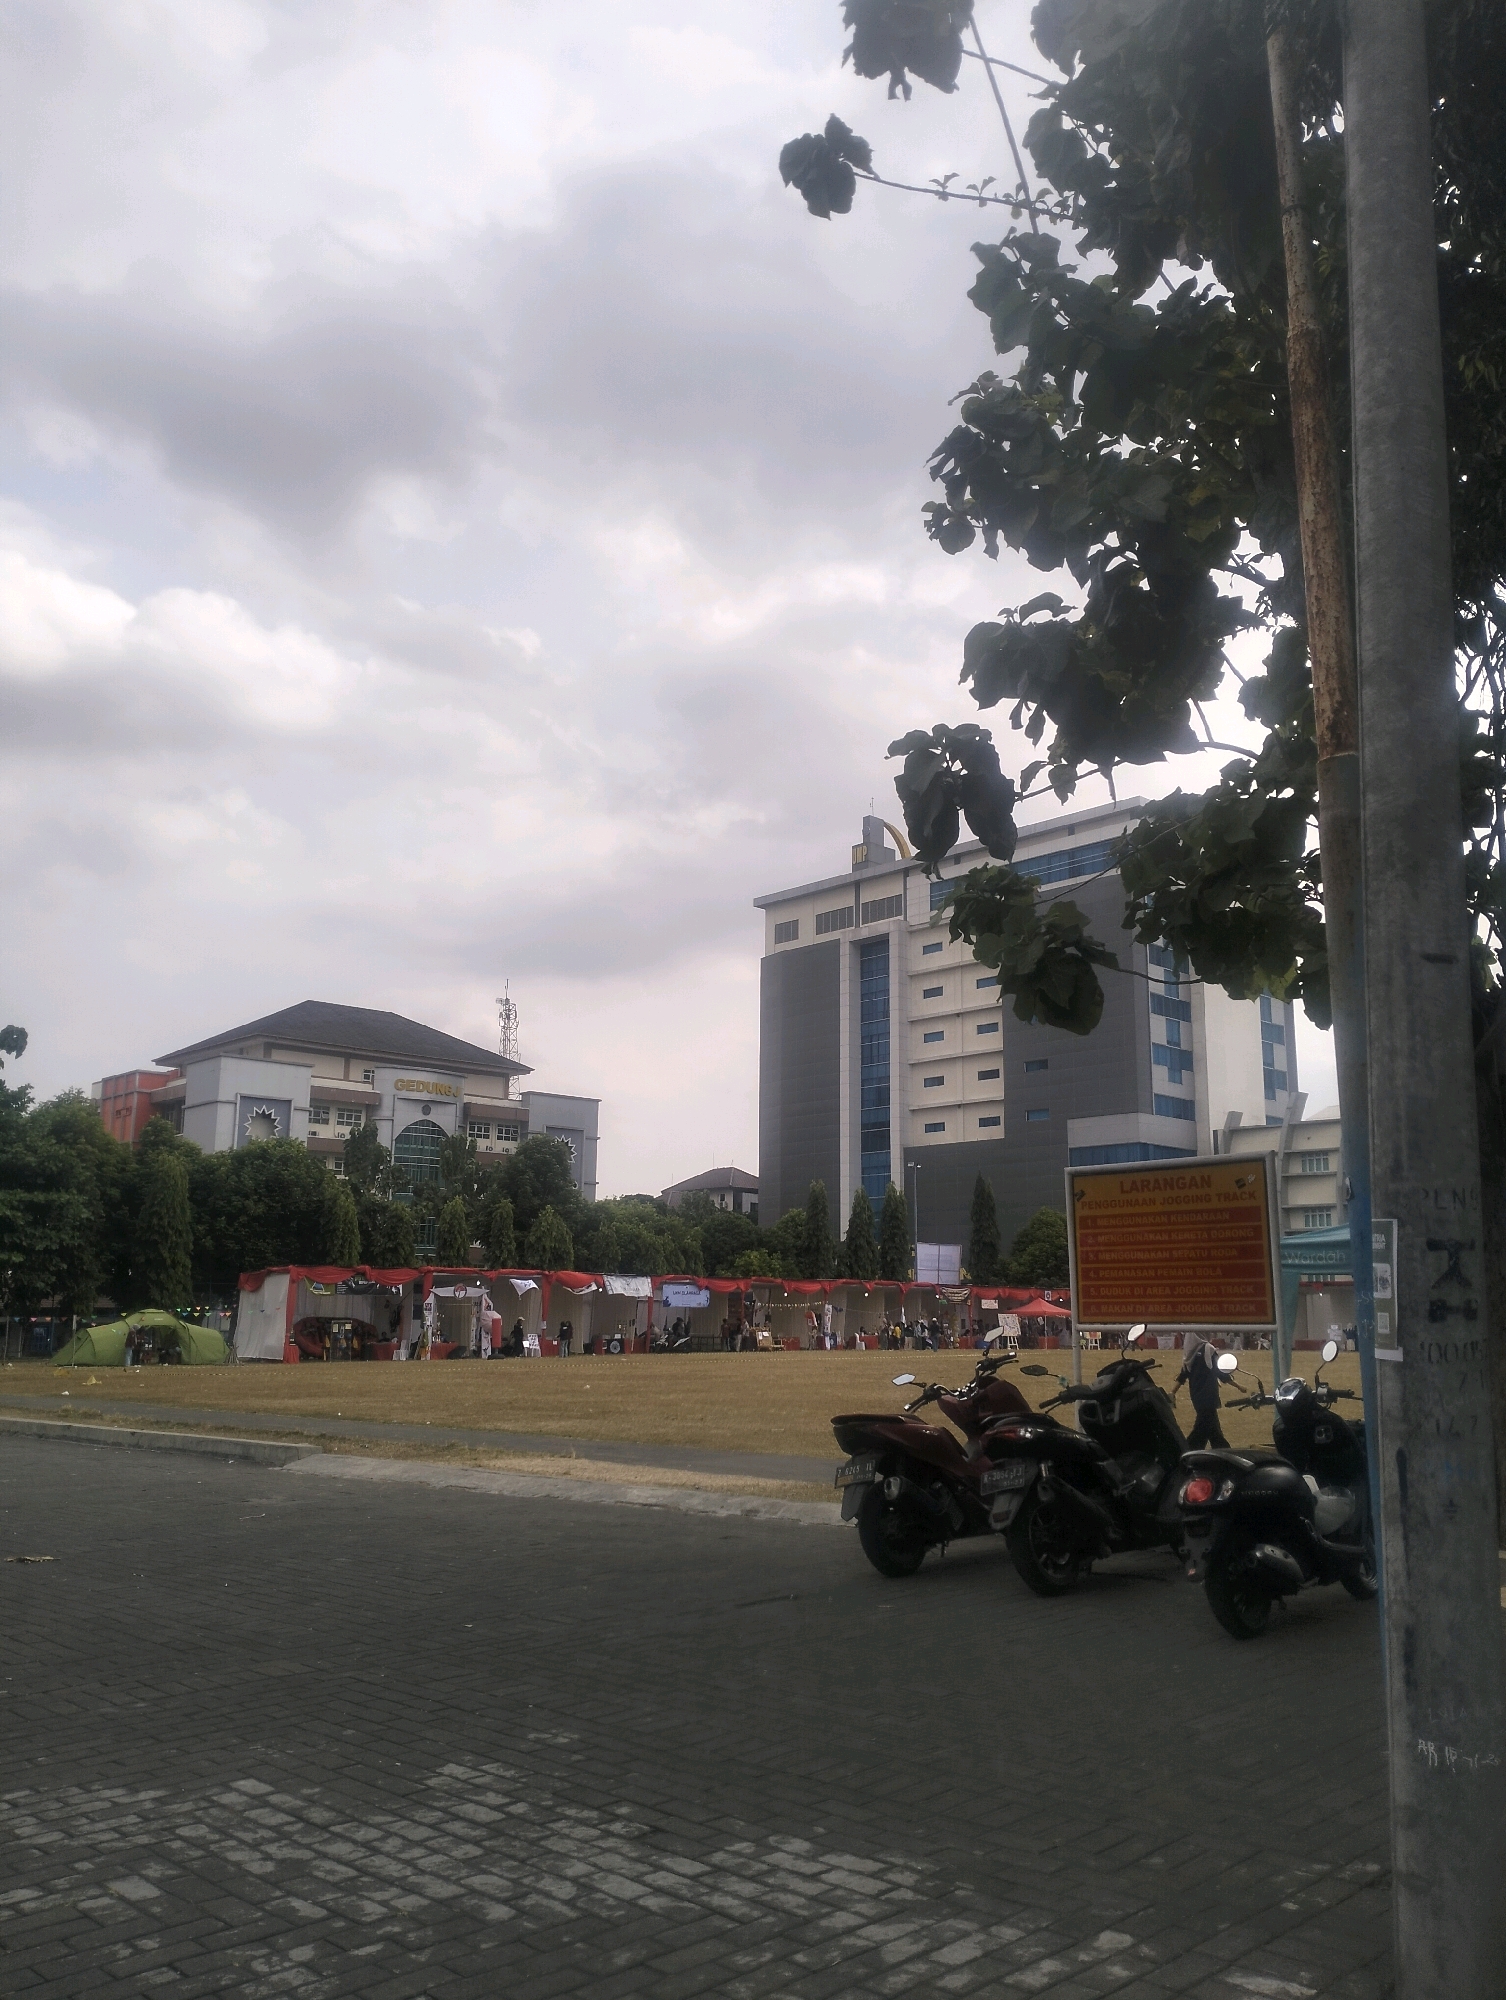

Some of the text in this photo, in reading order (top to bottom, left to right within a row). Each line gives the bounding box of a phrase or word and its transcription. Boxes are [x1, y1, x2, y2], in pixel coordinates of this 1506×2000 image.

[394, 1078, 452, 1097] GEDUNG
[1119, 1174, 1212, 1195] LARANGAN
[1081, 1190, 1257, 1210] PENGGUNAAN JOGGING TRACK
[1096, 1214, 1168, 1226] MENGGUNAKAN
[1097, 1232, 1169, 1243] MENGGUNAKAN
[1098, 1250, 1170, 1261] MENGGUNAKAN
[1284, 1249, 1346, 1264] Wardah
[1099, 1268, 1155, 1278] PEMANASAN
[1134, 1286, 1143, 1295] DI
[1146, 1286, 1171, 1295] AREA
[1173, 1285, 1217, 1295] JOGGING
[1220, 1285, 1255, 1294] TRACK
[1101, 1304, 1134, 1313] MAKAN
[1136, 1304, 1145, 1313] DI
[1148, 1304, 1172, 1313] AREA
[1175, 1303, 1219, 1313] JOGGING
[1221, 1303, 1257, 1313] TRACK
